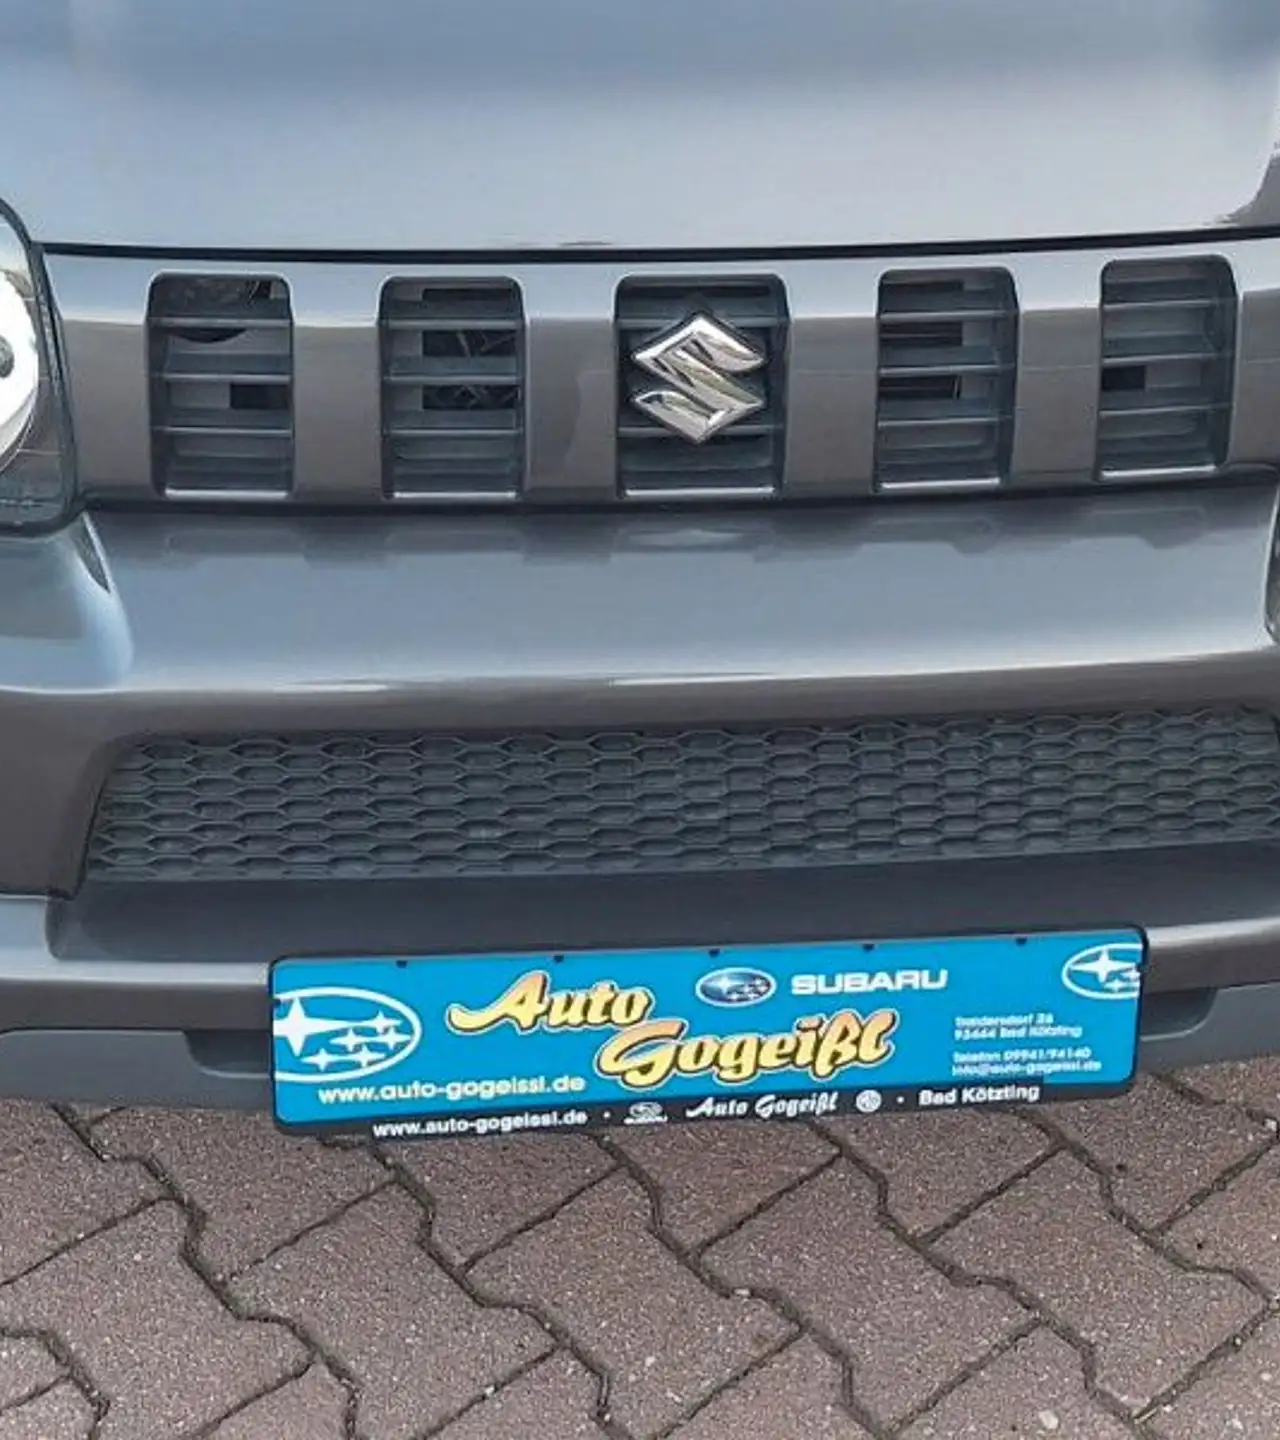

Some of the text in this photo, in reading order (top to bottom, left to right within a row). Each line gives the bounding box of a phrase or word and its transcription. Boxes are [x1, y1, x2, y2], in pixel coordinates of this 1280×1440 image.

[791, 968, 949, 996] SUBARU
[448, 969, 652, 1032] Auto
[318, 1074, 586, 1104] www.auto-gogeissl.de
[920, 1084, 1040, 1106] Bad Kötzting
[686, 1099, 747, 1118] Auto
[373, 1110, 588, 1138] www.auto-gogeissl.de
